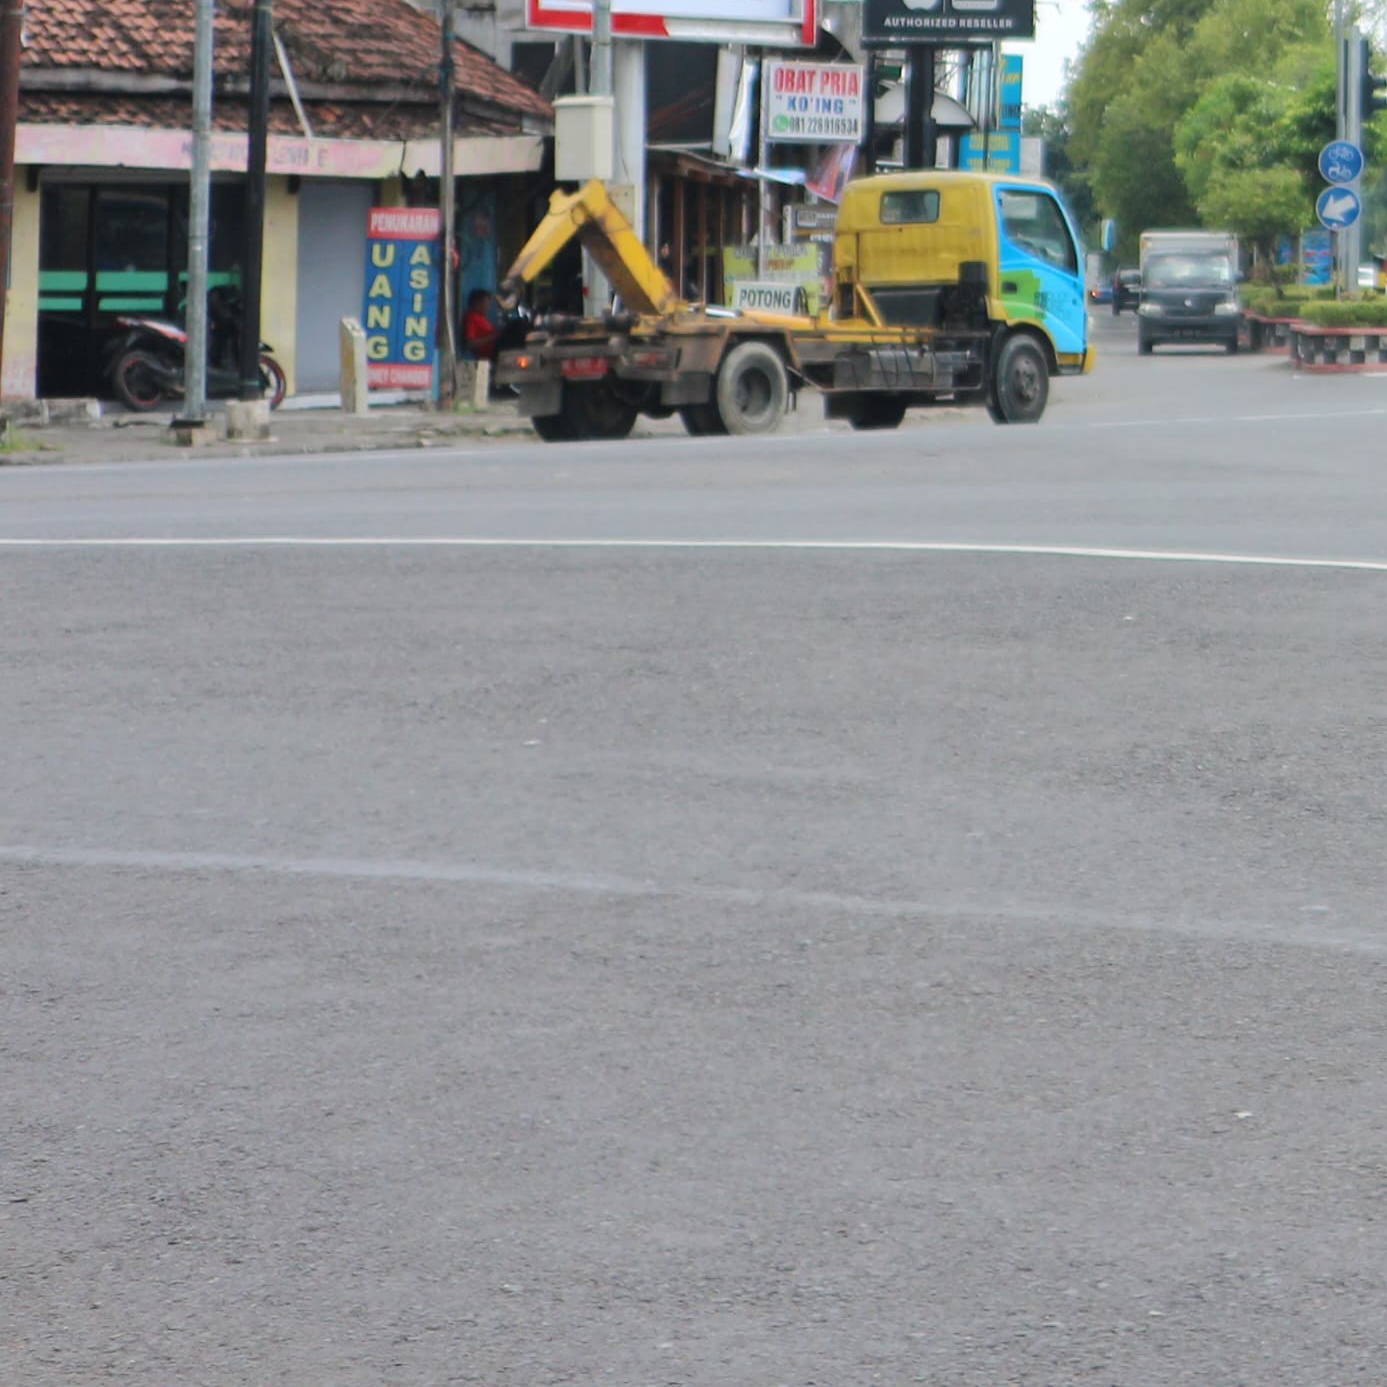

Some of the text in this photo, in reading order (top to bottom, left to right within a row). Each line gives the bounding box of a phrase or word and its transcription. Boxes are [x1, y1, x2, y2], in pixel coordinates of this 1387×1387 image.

[884, 17, 1013, 28] AUTHORIZED RESELLER
[775, 68, 858, 96] OBAT PRIA
[367, 243, 395, 359] UANG
[403, 245, 431, 361] ASING
[740, 289, 791, 309] POTONG
